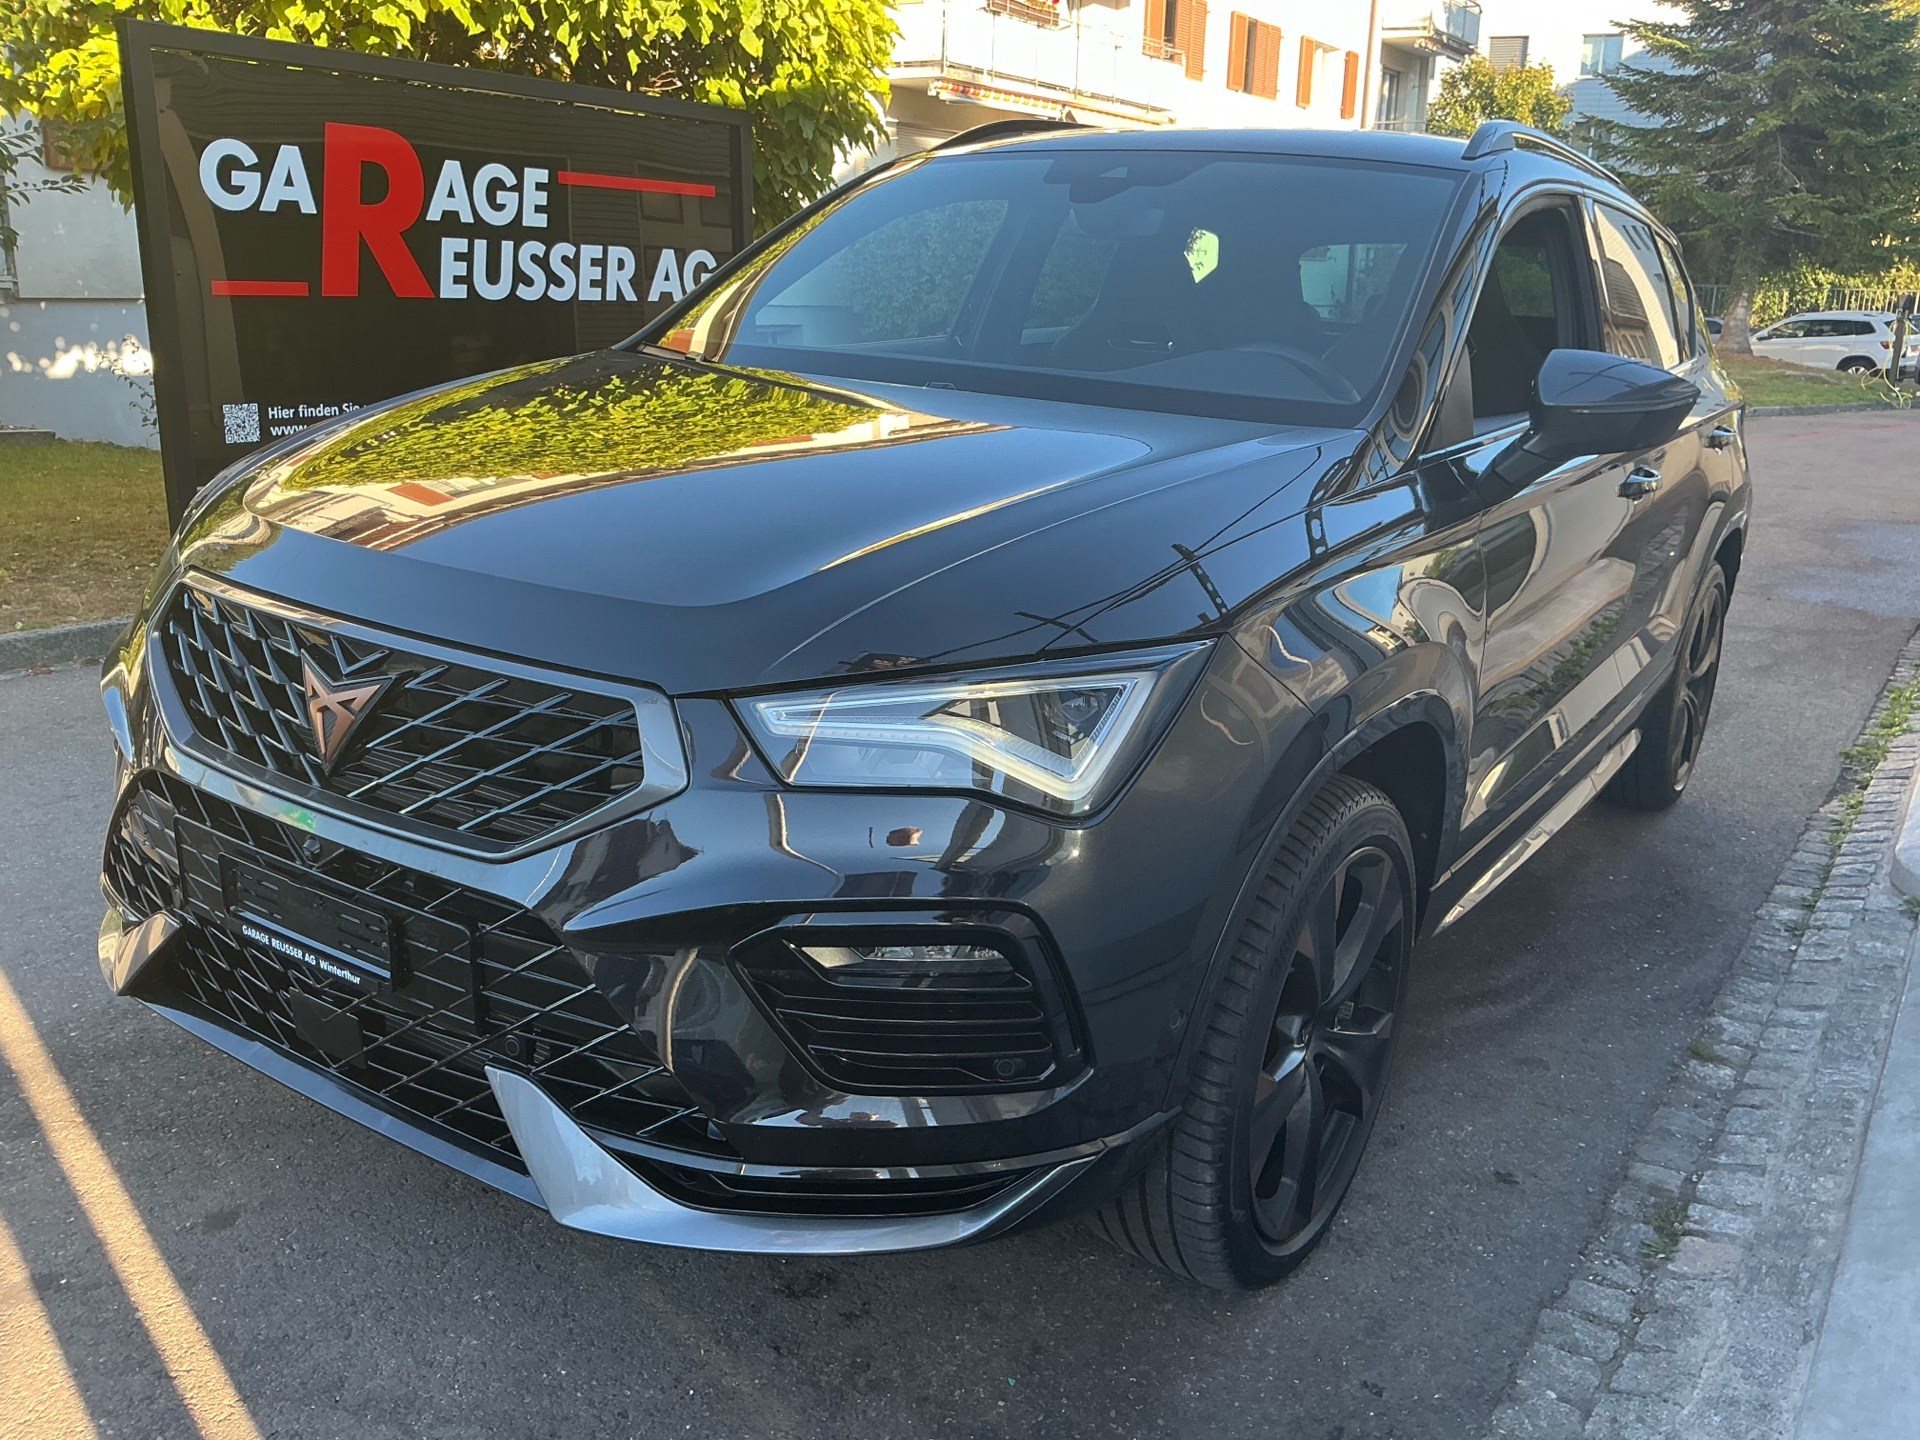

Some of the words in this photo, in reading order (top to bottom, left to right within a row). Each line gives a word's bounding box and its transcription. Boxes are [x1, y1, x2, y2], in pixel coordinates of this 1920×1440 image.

[199, 122, 549, 298] GARAGE
[647, 248, 717, 301] AG
[268, 405, 296, 419] Hier
[298, 403, 340, 418] finden
[242, 925, 270, 945] GARAGE
[271, 938, 303, 960] REUSSER
[304, 953, 316, 965] AG
[319, 959, 361, 985] Winterthur
